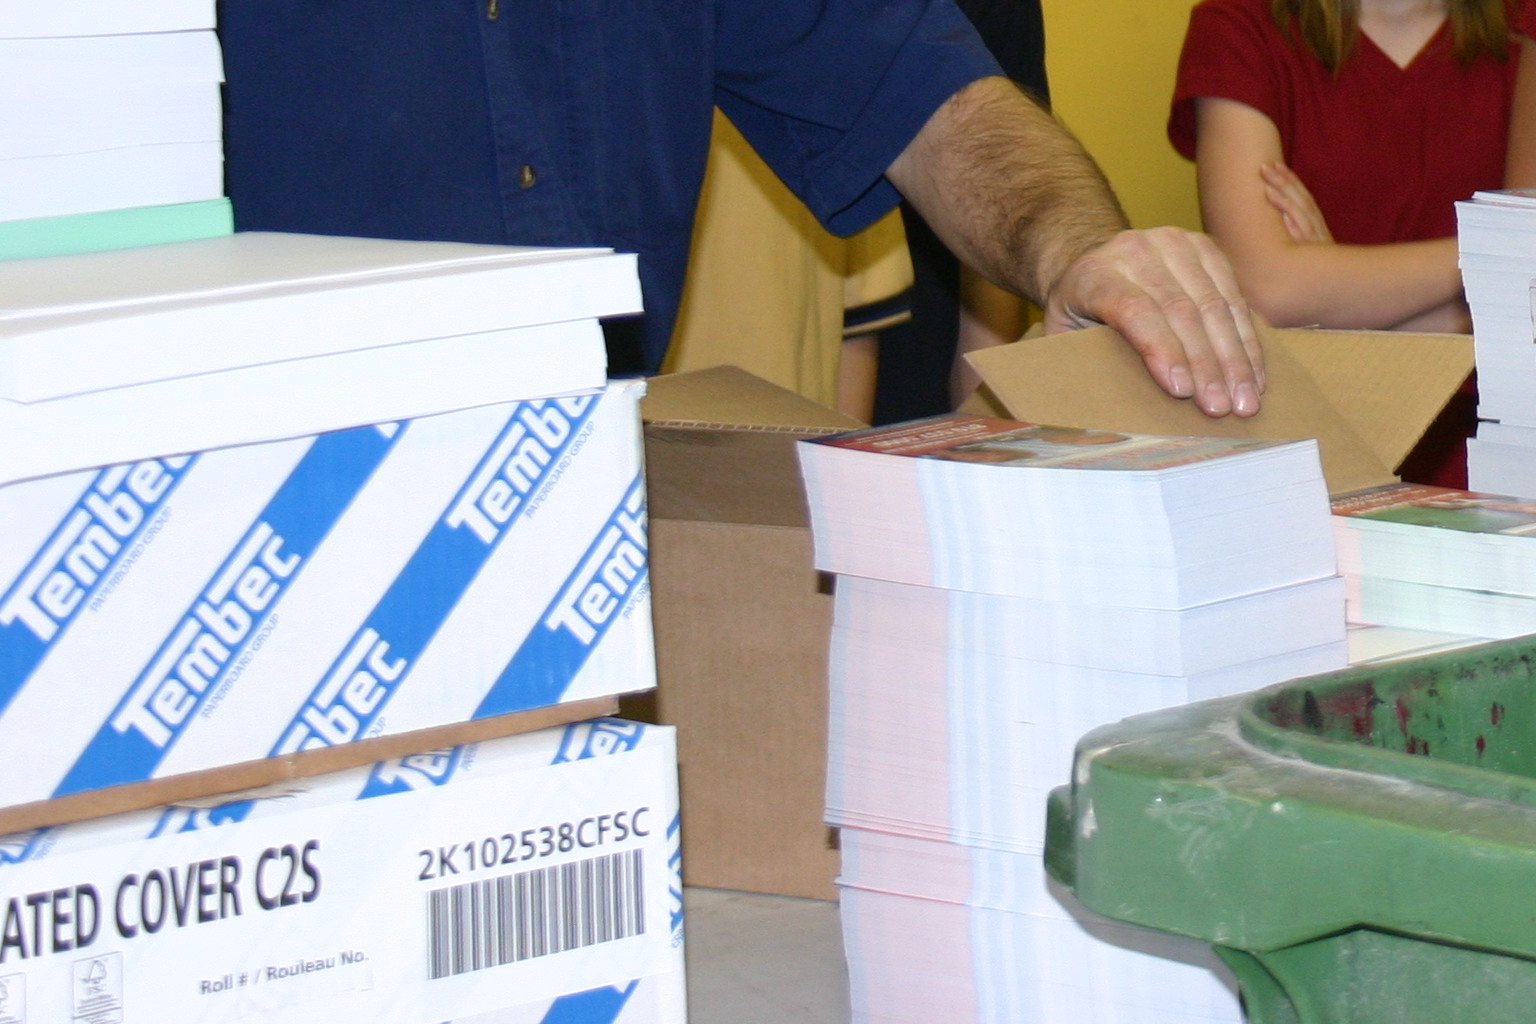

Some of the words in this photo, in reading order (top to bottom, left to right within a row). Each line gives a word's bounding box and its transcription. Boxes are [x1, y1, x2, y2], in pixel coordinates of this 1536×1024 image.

[446, 395, 593, 545] Tembe
[525, 456, 572, 520] PAPERBOARD
[570, 420, 595, 456] GROUP
[0, 456, 193, 643] Tembe
[89, 544, 146, 613] PAPERBOARD
[143, 506, 172, 544] GROUP
[110, 521, 302, 749] Tembec
[201, 650, 255, 719] PAPERBOARD
[251, 612, 281, 652] GROUP
[115, 855, 244, 939] COVER
[255, 839, 323, 911] C2S
[417, 806, 651, 882] 2K102538CFSC
[200, 973, 234, 995] Roll
[238, 971, 249, 986] #
[254, 969, 262, 984] /
[266, 956, 336, 981] Rouleau
[340, 949, 370, 966] No.
